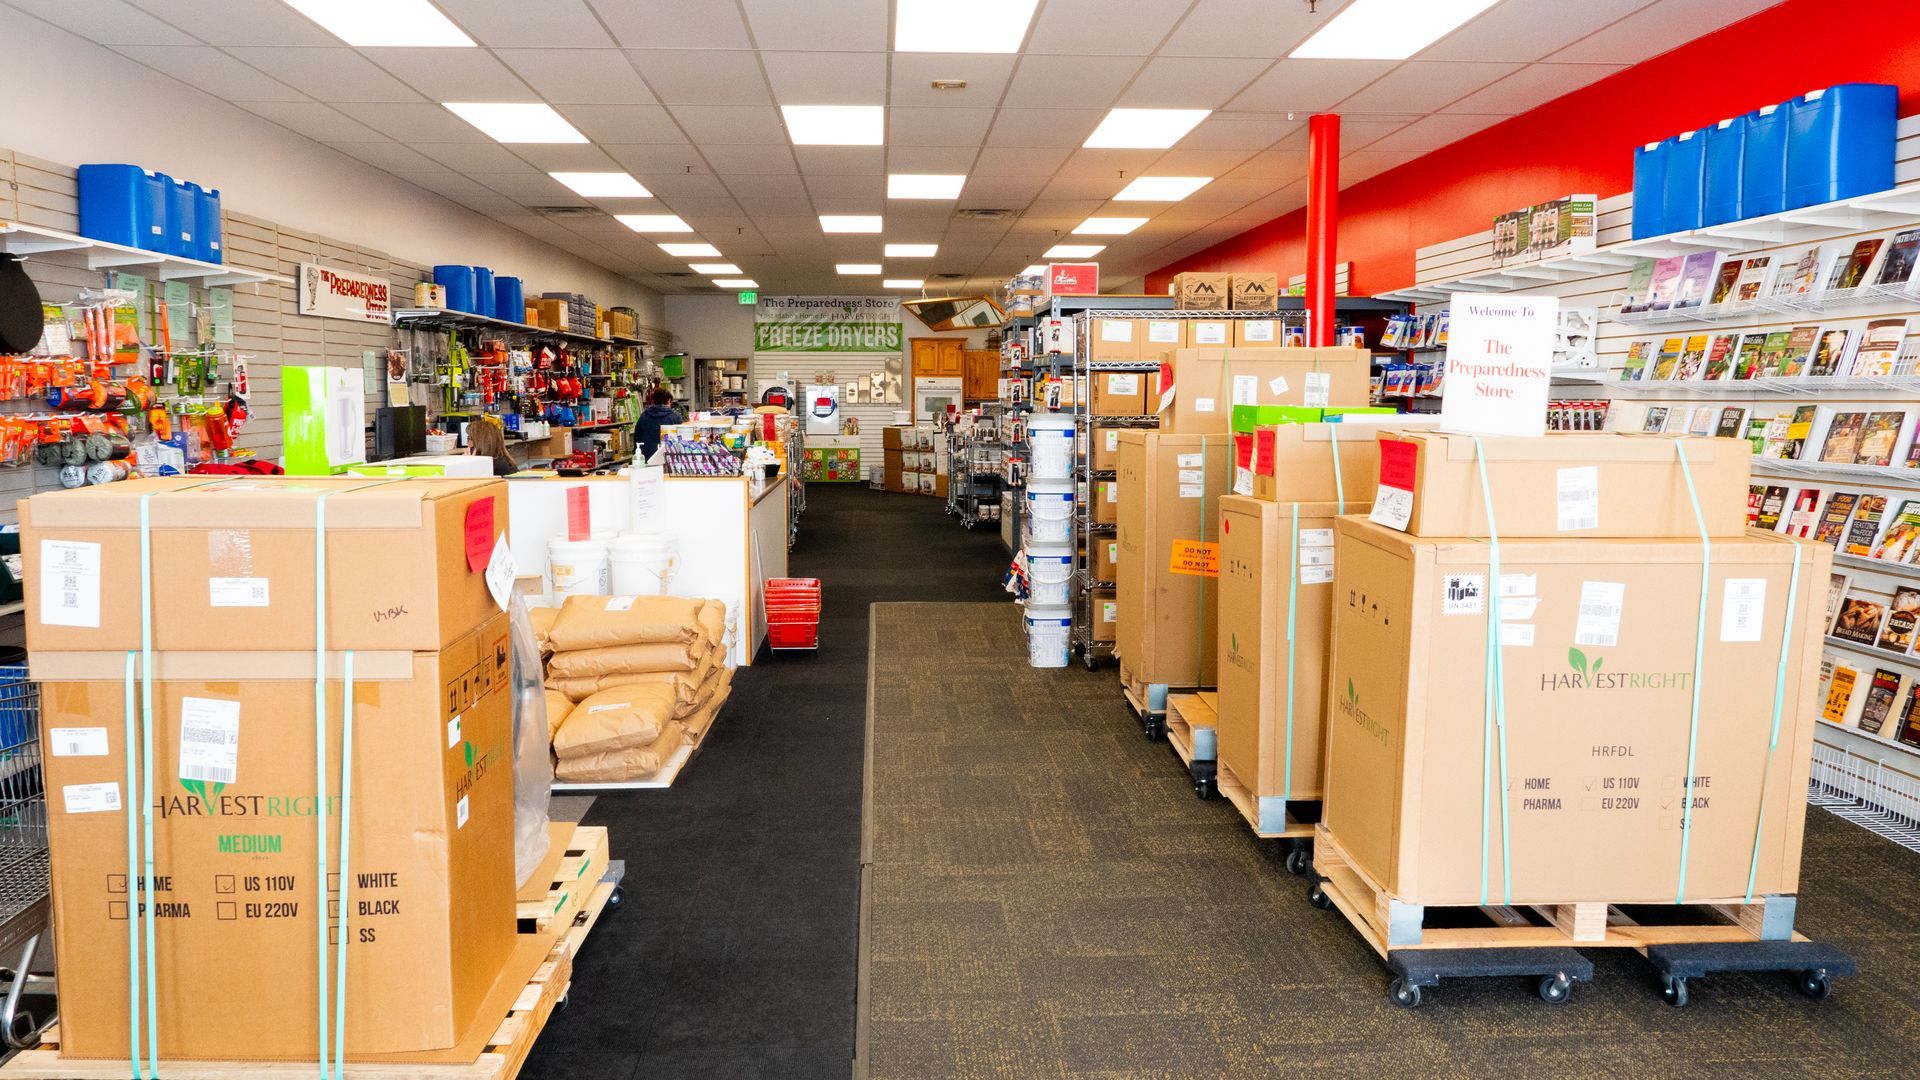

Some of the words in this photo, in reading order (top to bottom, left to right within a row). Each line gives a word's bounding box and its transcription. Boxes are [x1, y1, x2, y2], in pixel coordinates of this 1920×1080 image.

[330, 273, 387, 302] PREPAREDNESS
[764, 298, 785, 308] The
[787, 298, 862, 310] Preparedness
[865, 298, 894, 308] Store
[1469, 305, 1518, 317] Welcome
[1521, 306, 1535, 317] To
[759, 325, 823, 347] FREEZE
[828, 325, 899, 348] DRYERS
[1484, 339, 1513, 355] The
[1449, 359, 1546, 379] Preparedness
[1474, 380, 1514, 399] Store
[1541, 673, 1690, 691] HARVESTRIGHT
[1591, 745, 1635, 757] HRFDL
[1524, 777, 1551, 790] HOME
[1603, 777, 1615, 789] US
[1618, 777, 1640, 790] 110V
[1523, 798, 1562, 811] PHARMA
[1601, 797, 1614, 810] EU
[1615, 797, 1640, 810] 220V
[218, 834, 282, 854] MEDIUM
[137, 876, 173, 892] HME
[244, 876, 261, 892] US
[265, 876, 295, 892] 110V
[357, 872, 398, 889] WHITE
[138, 903, 191, 918] PARMA
[245, 902, 262, 918] EU
[264, 902, 299, 918] 220V
[358, 899, 400, 916] BLACK
[359, 927, 376, 943] SS
